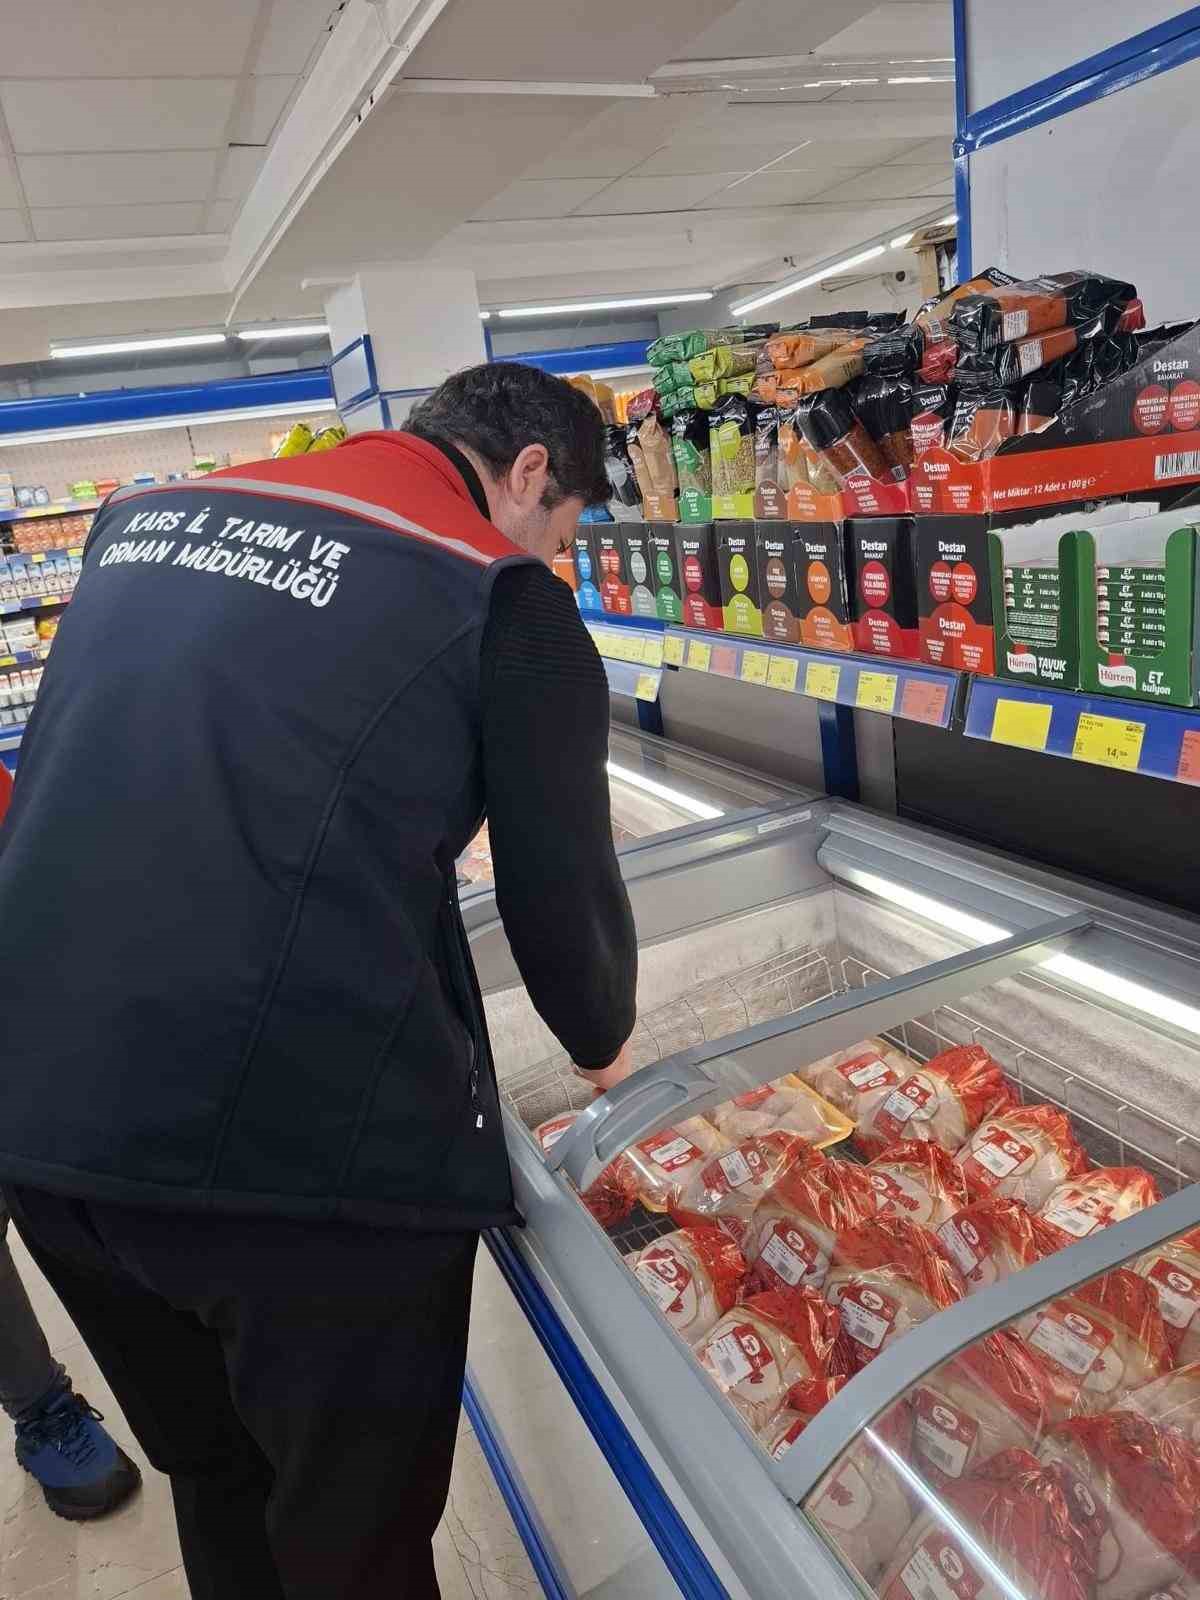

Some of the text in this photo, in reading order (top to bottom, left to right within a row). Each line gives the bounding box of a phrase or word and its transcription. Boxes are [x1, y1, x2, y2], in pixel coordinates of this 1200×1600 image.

[1153, 360, 1189, 372] Destan
[920, 394, 941, 406] Destan
[923, 462, 950, 473] Destan
[993, 490, 1006, 499] Net
[1007, 486, 1032, 498] Miktar:
[1034, 485, 1043, 494] 12
[1044, 483, 1060, 492] Adet
[1068, 480, 1081, 489] 100
[123, 511, 186, 534] KARS
[218, 516, 306, 552] TARIM
[308, 535, 350, 569] VE
[728, 537, 745, 546] Destan
[765, 540, 784, 550] Destan
[861, 540, 887, 551] Destan
[805, 543, 826, 553] Destan
[938, 541, 966, 553] Destan
[99, 539, 340, 608] ORMAN MÜDÜRLÜĞÜ
[868, 618, 888, 628] Destan
[939, 617, 966, 631] Destan
[1009, 657, 1067, 672] Hürrem TAVUK
[1041, 669, 1064, 681] bulyon
[1100, 669, 1164, 685] Hürrem ET
[1142, 682, 1171, 696] bulyon
